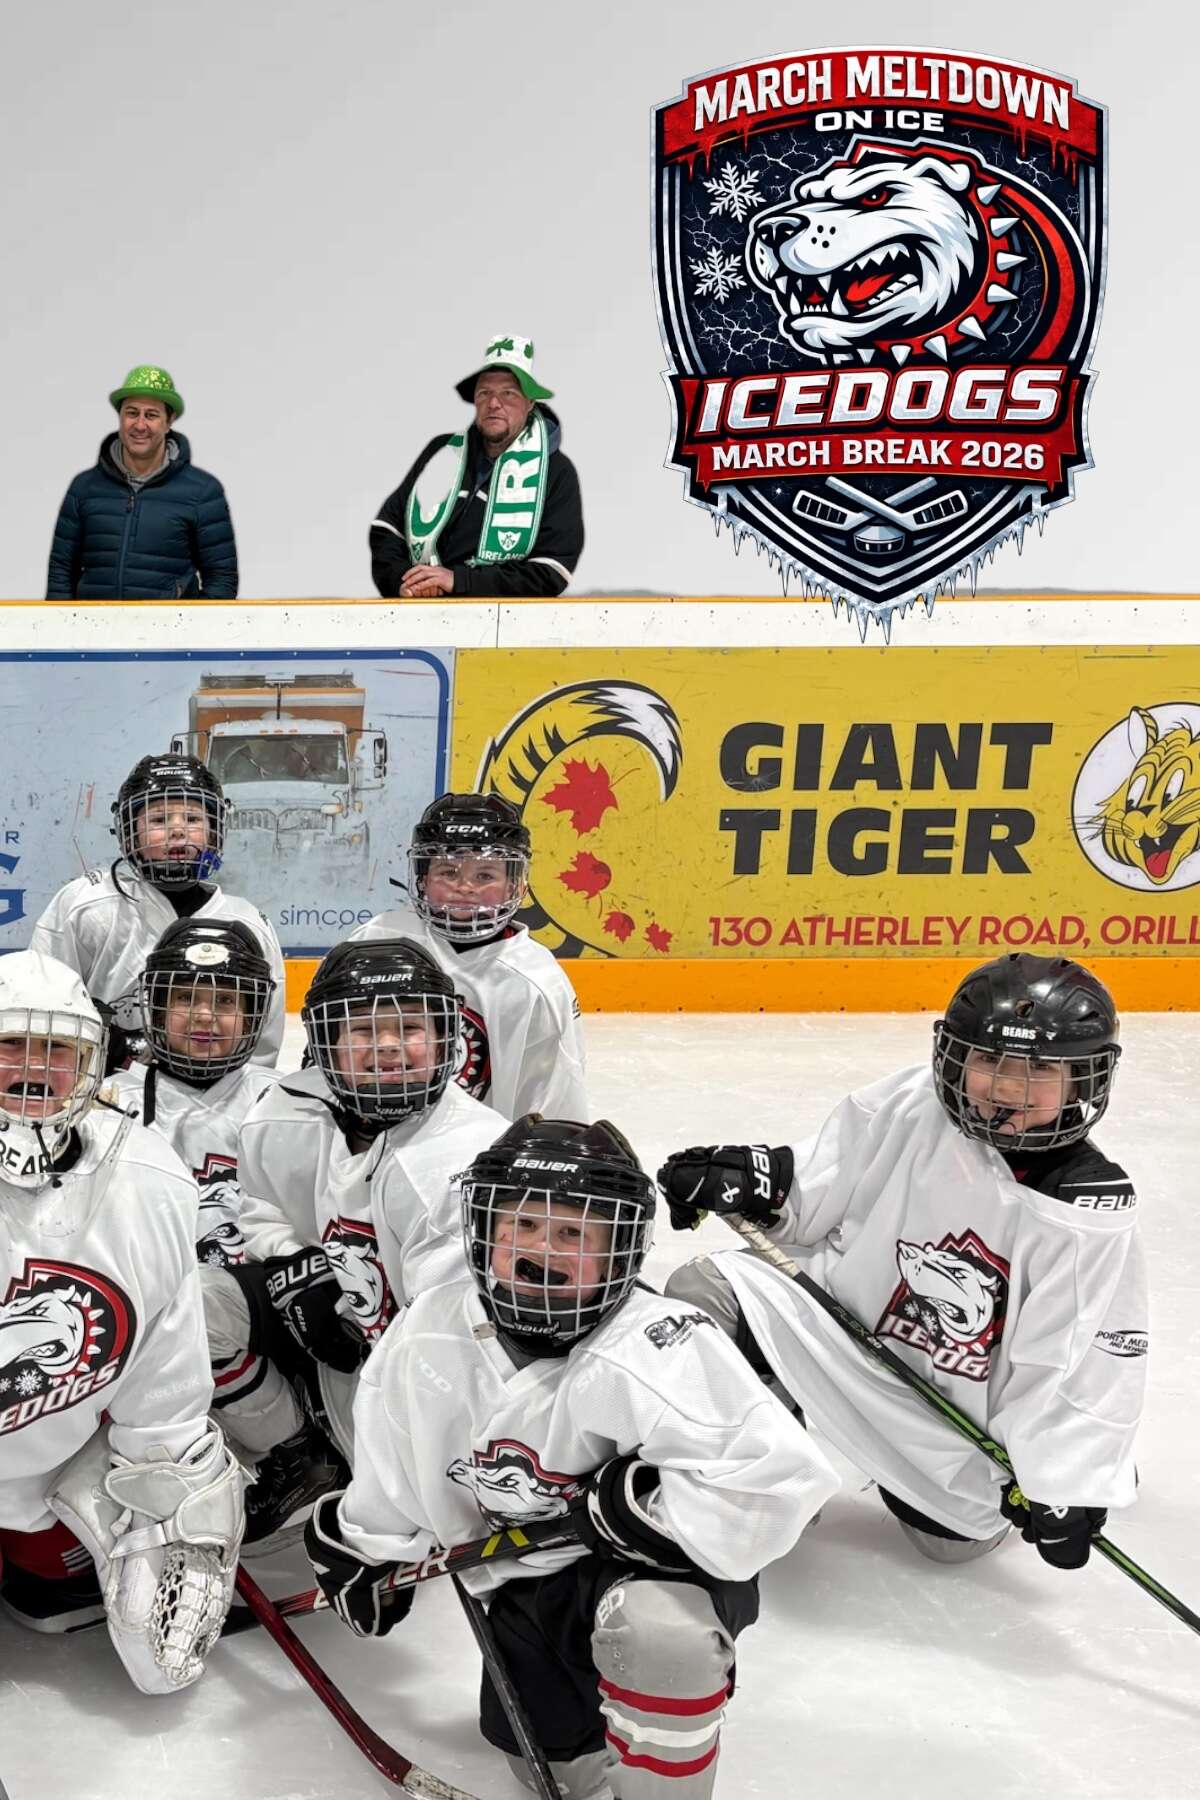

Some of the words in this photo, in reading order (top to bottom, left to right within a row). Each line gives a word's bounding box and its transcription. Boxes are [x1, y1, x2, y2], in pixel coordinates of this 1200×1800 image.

[719, 721, 1053, 792] GIANT
[446, 824, 485, 835] CCM
[719, 808, 1036, 876] TIGER
[280, 904, 373, 927] simcoe
[709, 916, 772, 947] 130
[784, 916, 972, 947] ATHERLEY
[977, 915, 1091, 949] ROAD,
[358, 972, 413, 985] BAUER
[1001, 1024, 1037, 1040] BEARS
[512, 1157, 579, 1173] BAUER
[265, 1253, 329, 1299] BAUE
